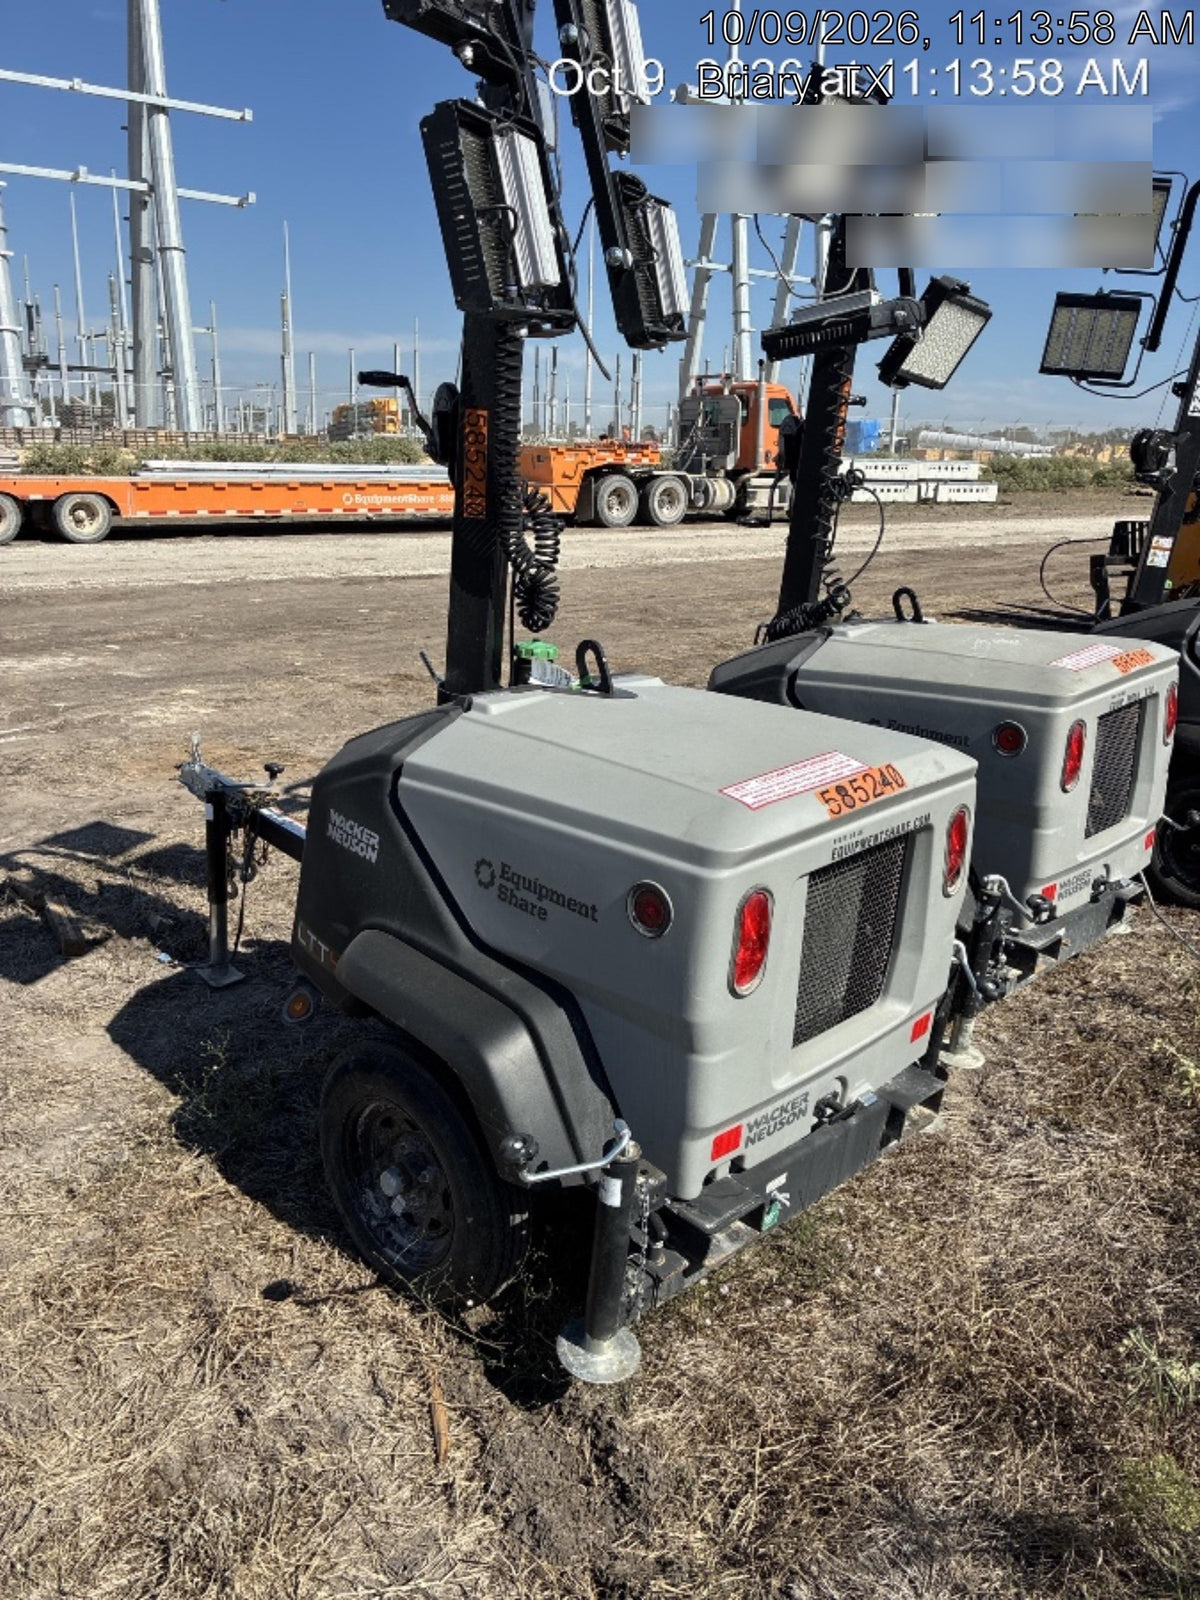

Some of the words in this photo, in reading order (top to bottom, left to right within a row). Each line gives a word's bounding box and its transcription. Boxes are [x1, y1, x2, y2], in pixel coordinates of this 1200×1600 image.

[464, 409, 487, 518] 585240
[820, 763, 905, 815] 585240
[326, 823, 379, 864] NEUSON
[329, 808, 380, 849] WACKER
[496, 883, 550, 923] Share
[498, 861, 599, 924] Equipment
[744, 1105, 809, 1149] NEUSON
[745, 1091, 810, 1134] WACKER
